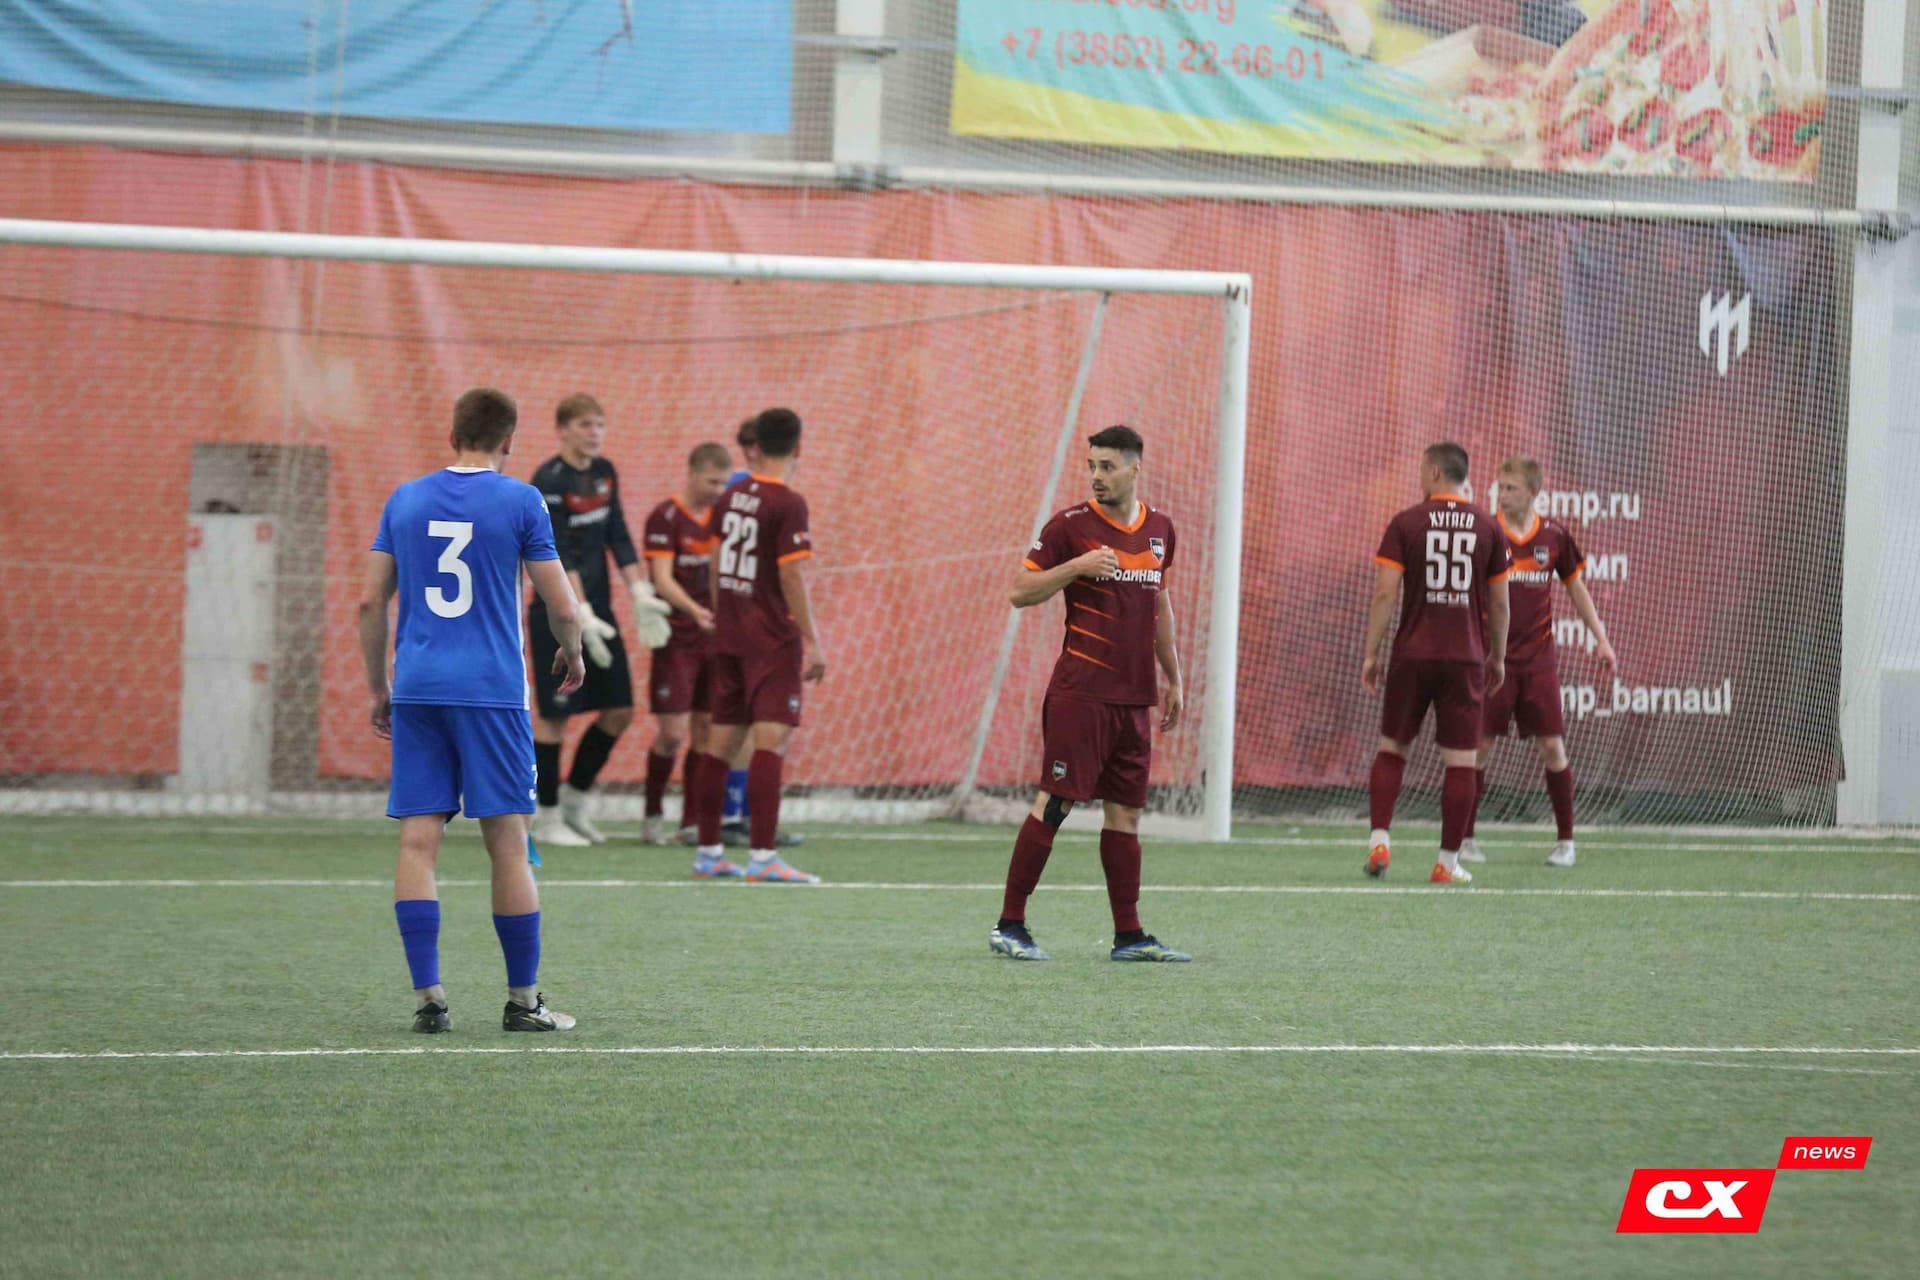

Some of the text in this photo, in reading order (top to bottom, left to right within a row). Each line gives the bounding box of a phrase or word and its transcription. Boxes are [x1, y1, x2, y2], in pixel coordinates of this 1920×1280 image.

[1001, 27, 1325, 80] +7 (3852) 22-66-01
[425, 520, 474, 619] 3
[719, 511, 759, 580] 22
[1426, 530, 1477, 591] 55
